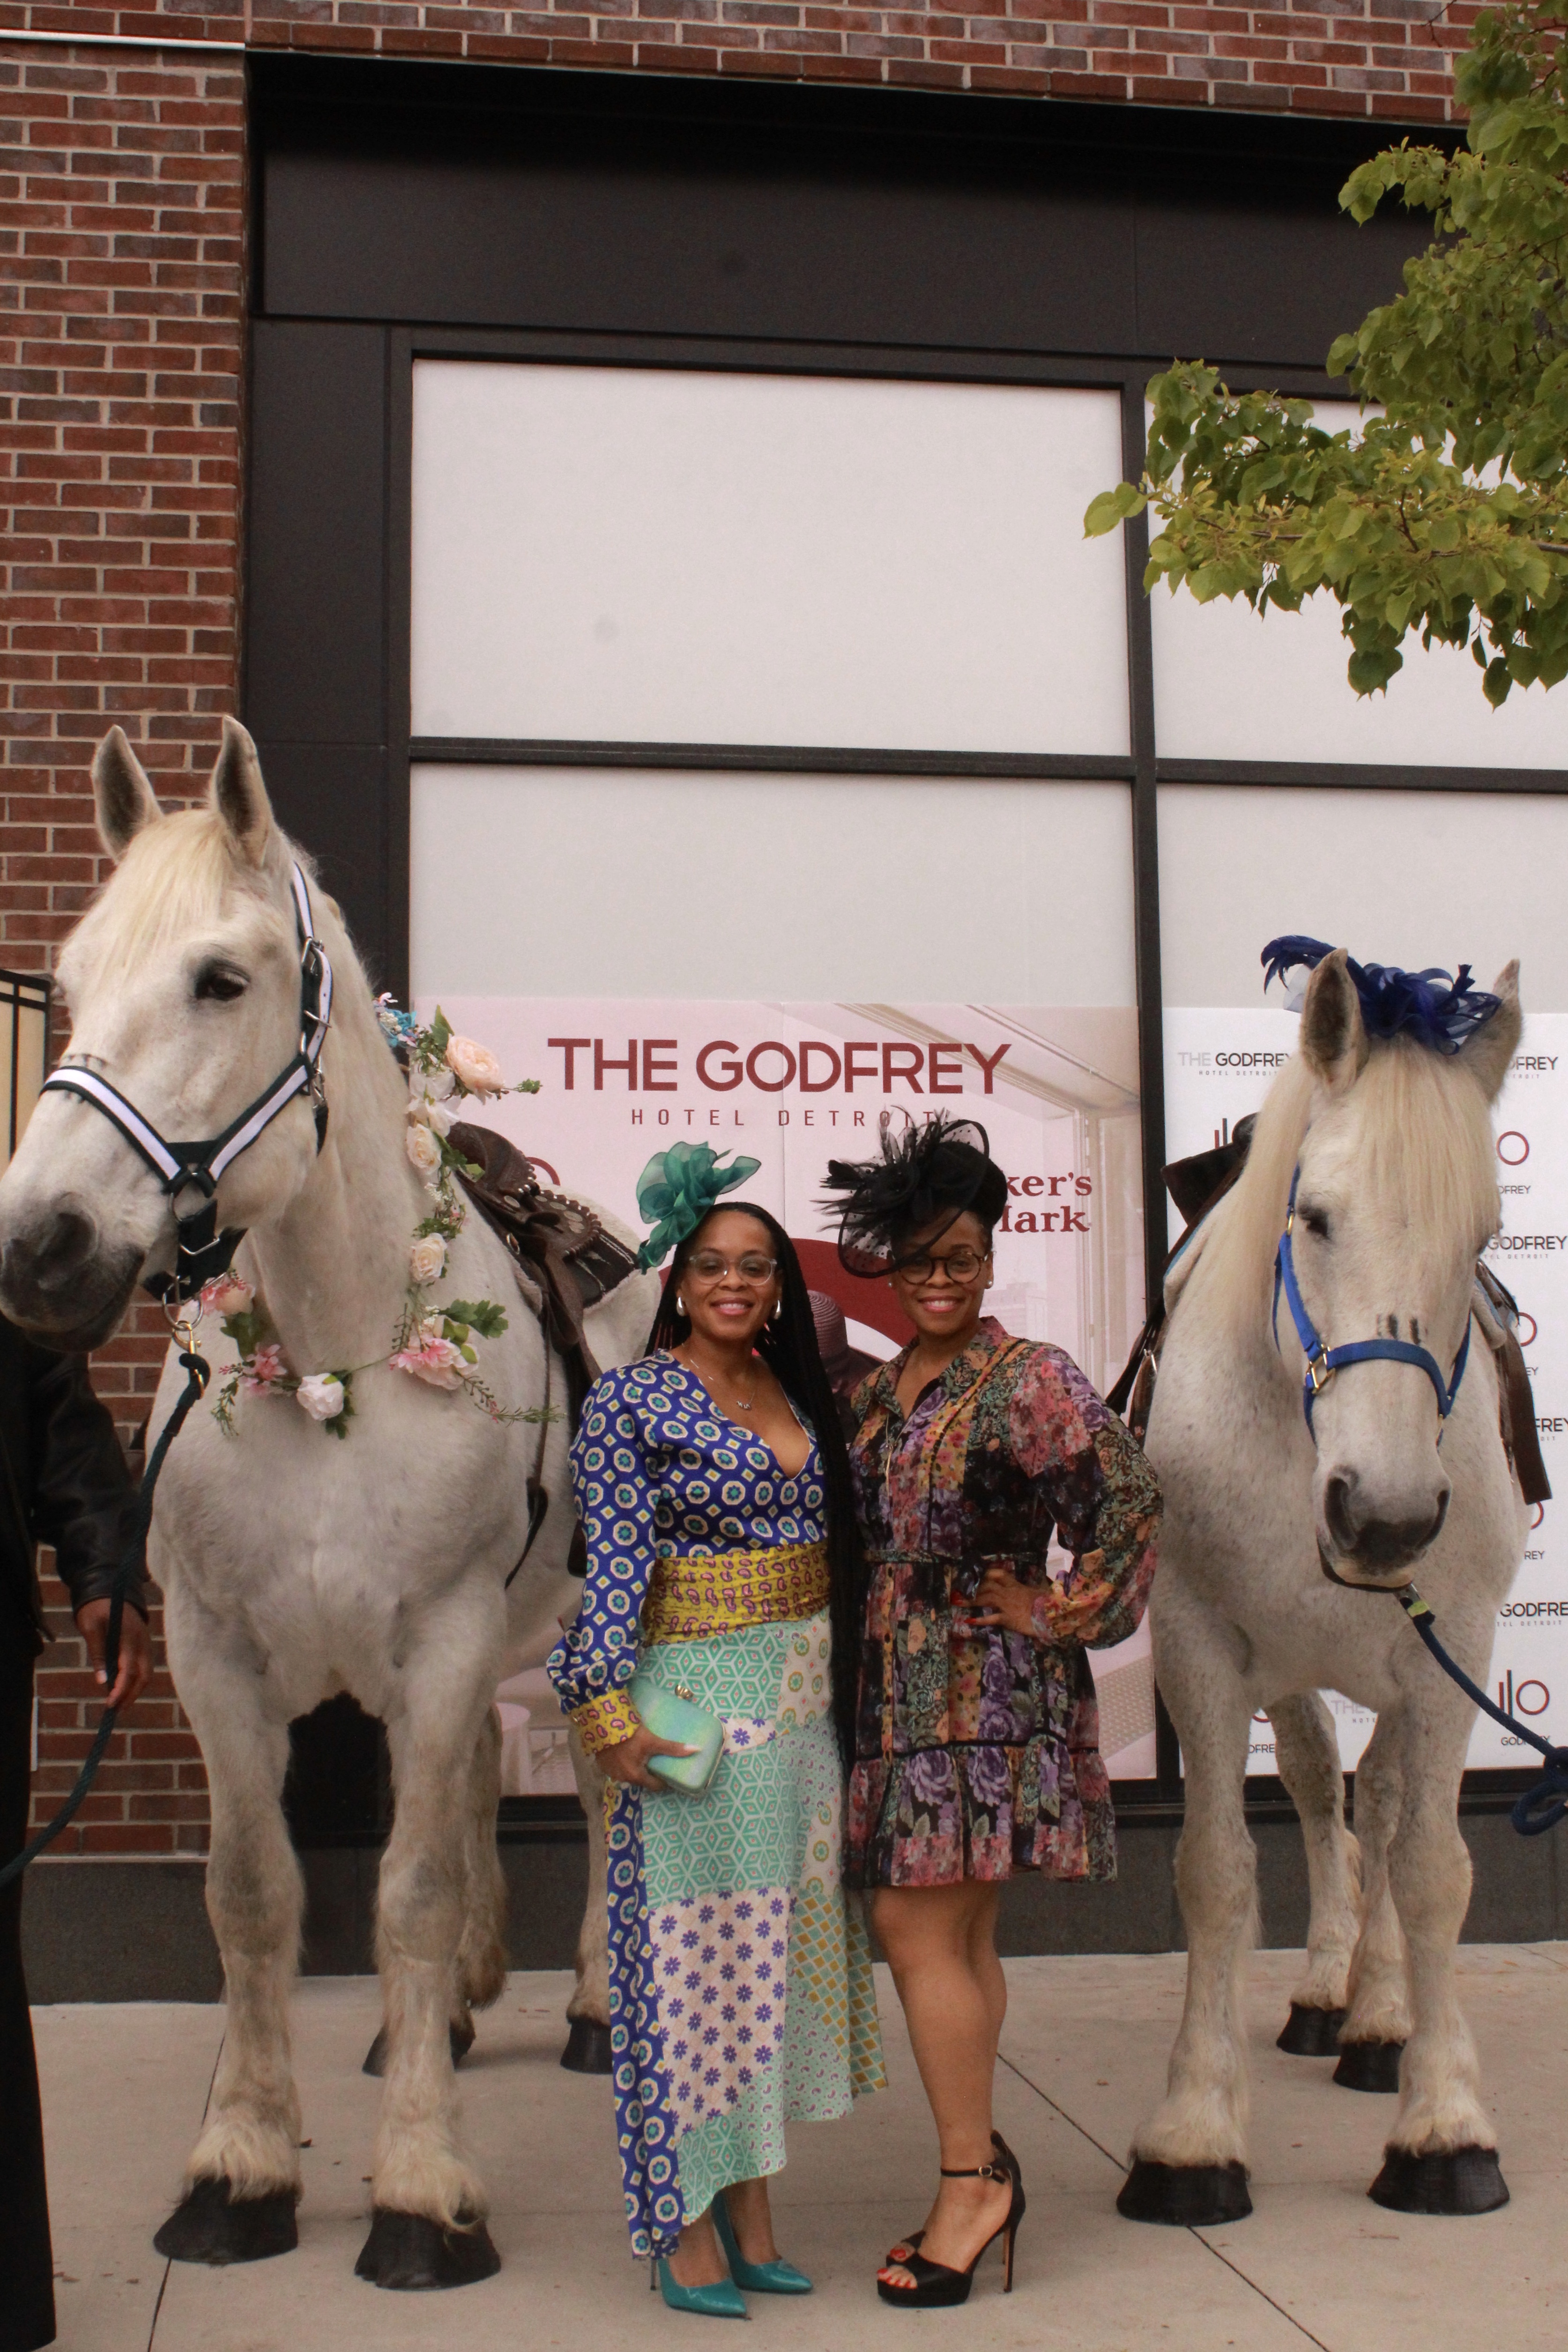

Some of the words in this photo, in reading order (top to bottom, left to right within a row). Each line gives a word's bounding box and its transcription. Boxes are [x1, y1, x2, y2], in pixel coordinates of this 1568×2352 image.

[548, 1038, 677, 1091] THE
[696, 1040, 1012, 1094] GODFREY
[1178, 1052, 1211, 1066] THE
[1509, 1056, 1558, 1070] FREY
[632, 1109, 744, 1126] HOTEL
[1006, 1172, 1092, 1196] ker's
[1498, 1185, 1531, 1194] DFREY
[1500, 1602, 1568, 1617] GODFRE
